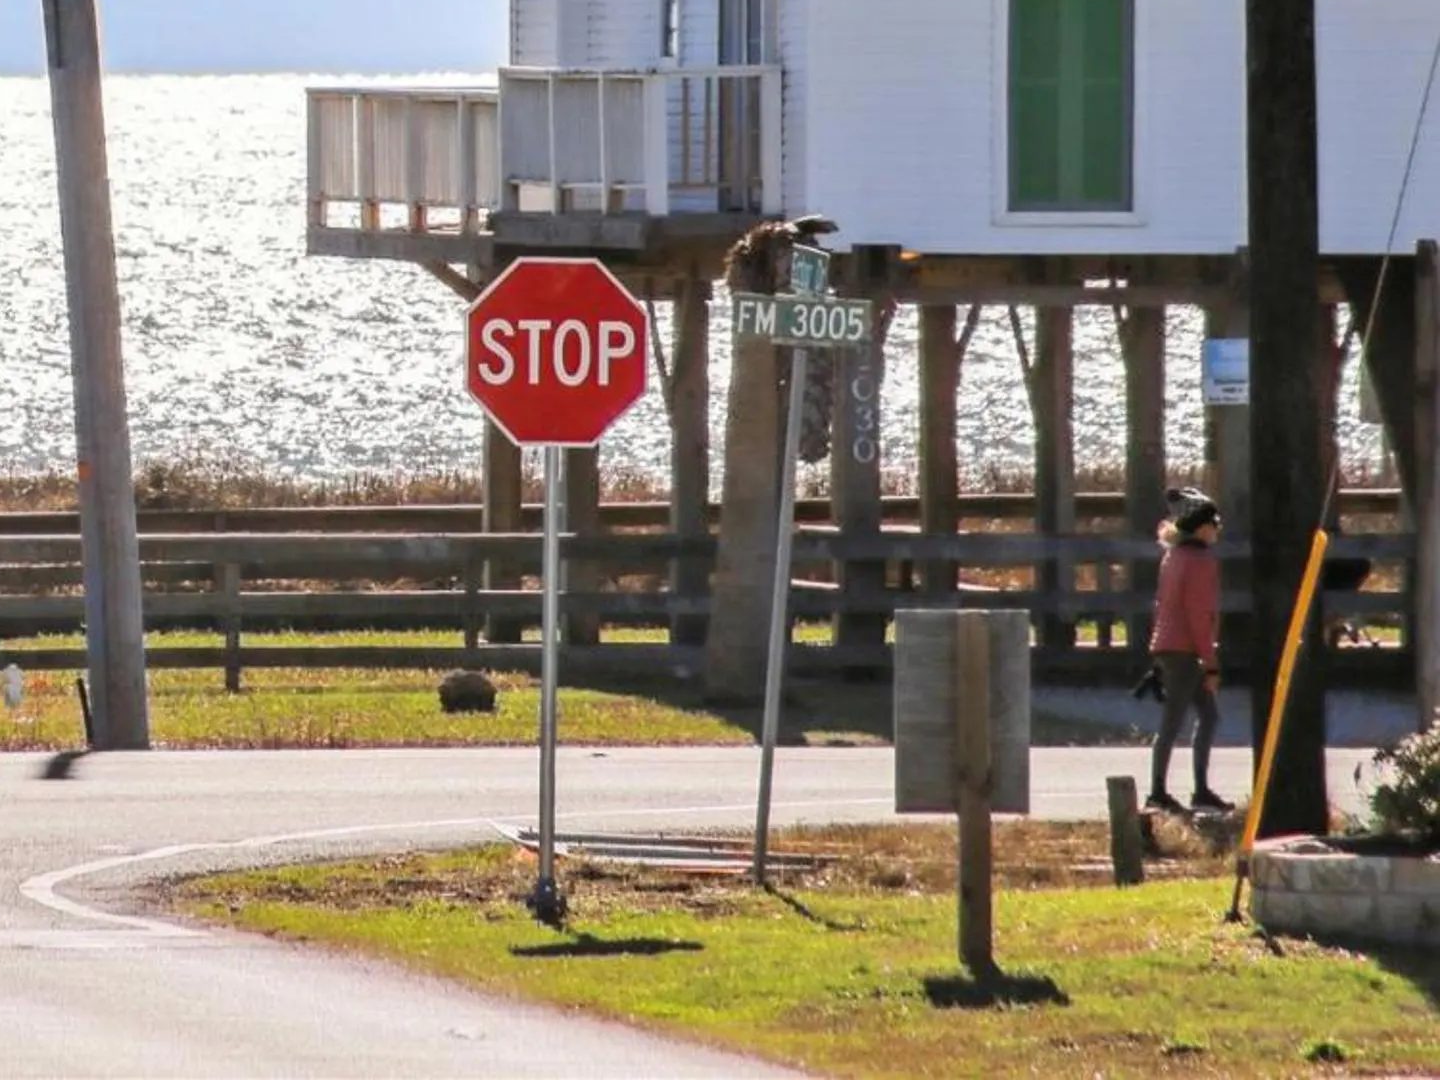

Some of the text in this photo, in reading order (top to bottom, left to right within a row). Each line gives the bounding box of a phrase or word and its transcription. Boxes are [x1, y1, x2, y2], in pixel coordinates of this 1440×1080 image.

[737, 301, 865, 340] FM 3005
[478, 318, 636, 387] STOP
